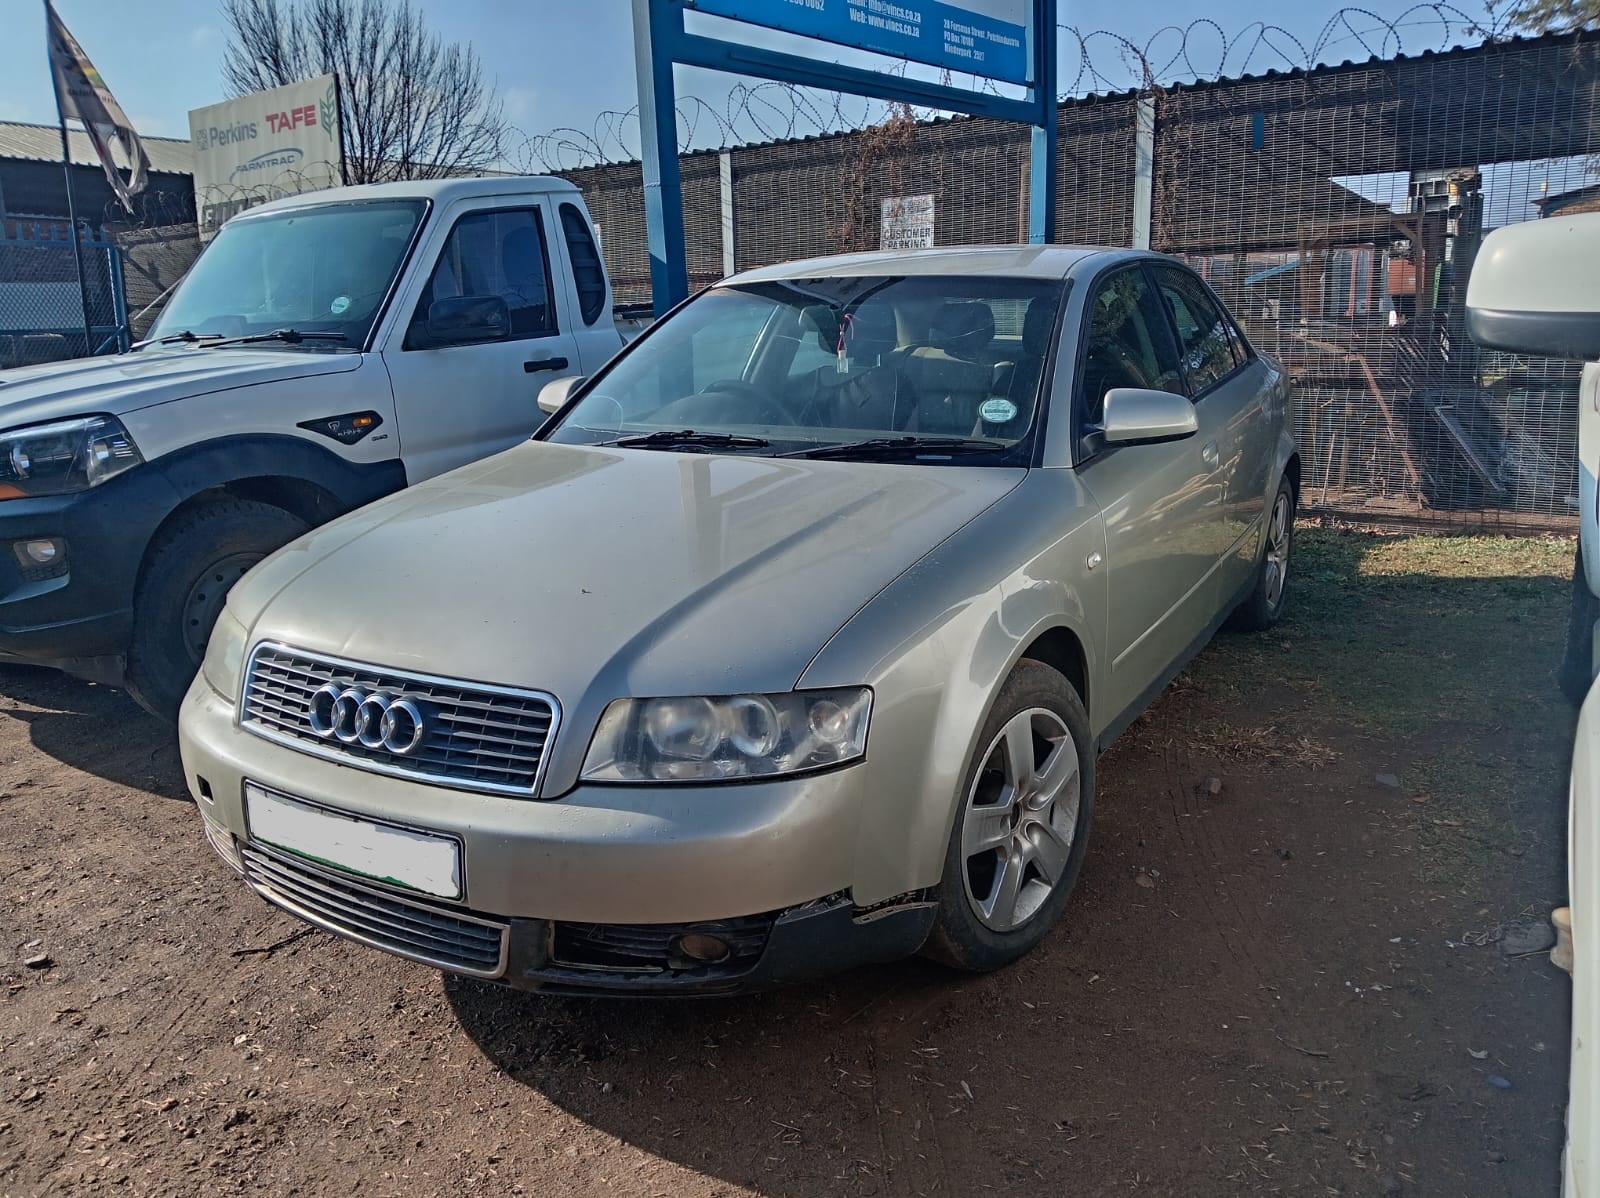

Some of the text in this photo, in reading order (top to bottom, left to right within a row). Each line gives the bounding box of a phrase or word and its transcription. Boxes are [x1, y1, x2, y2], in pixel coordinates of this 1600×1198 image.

[849, 7, 920, 38] Web: www.vincs.co.za
[210, 104, 317, 149] Perkins TAFE
[235, 155, 296, 173] FARMTRAC
[883, 228, 931, 240] CUSTOMER
